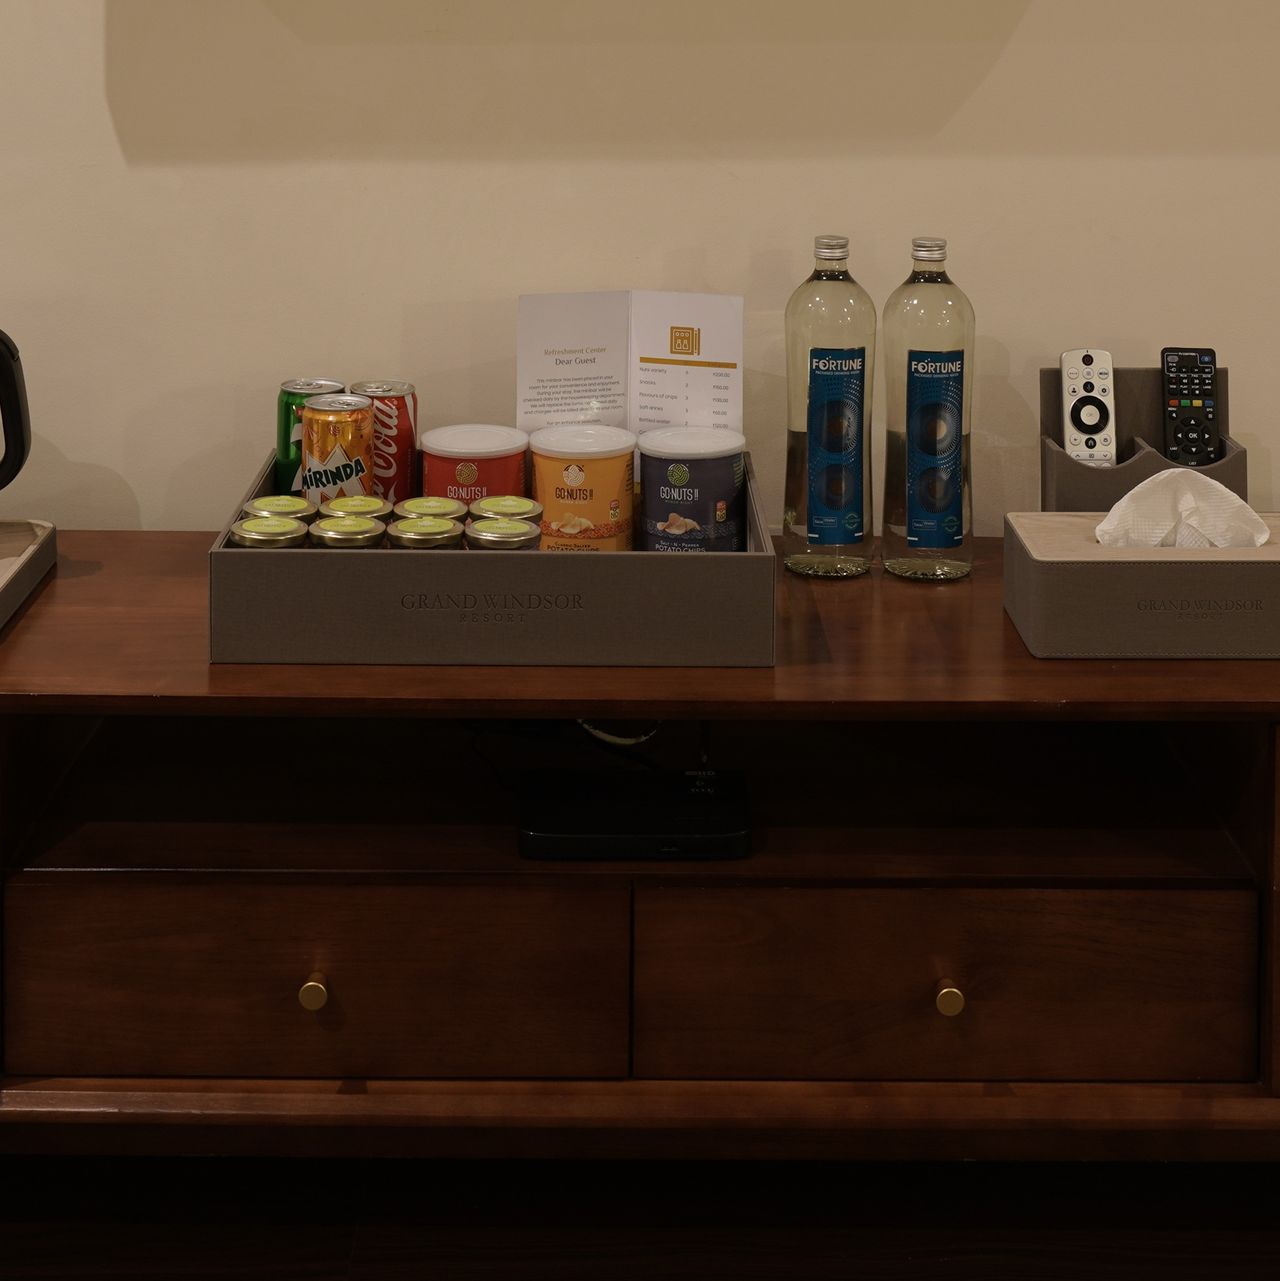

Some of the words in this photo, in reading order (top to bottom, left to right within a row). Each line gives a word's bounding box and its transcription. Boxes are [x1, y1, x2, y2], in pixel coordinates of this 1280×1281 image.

[544, 347, 584, 355] Refreshment
[574, 357, 596, 365] Guest
[812, 358, 863, 370] FORTUNE
[911, 360, 961, 373] FORTUNE
[401, 593, 477, 610] GRAND
[483, 593, 584, 610] WINDSOR
[1137, 600, 1191, 611] GRAND
[1192, 600, 1264, 611] WINDSOR
[459, 612, 526, 624] RESORT
